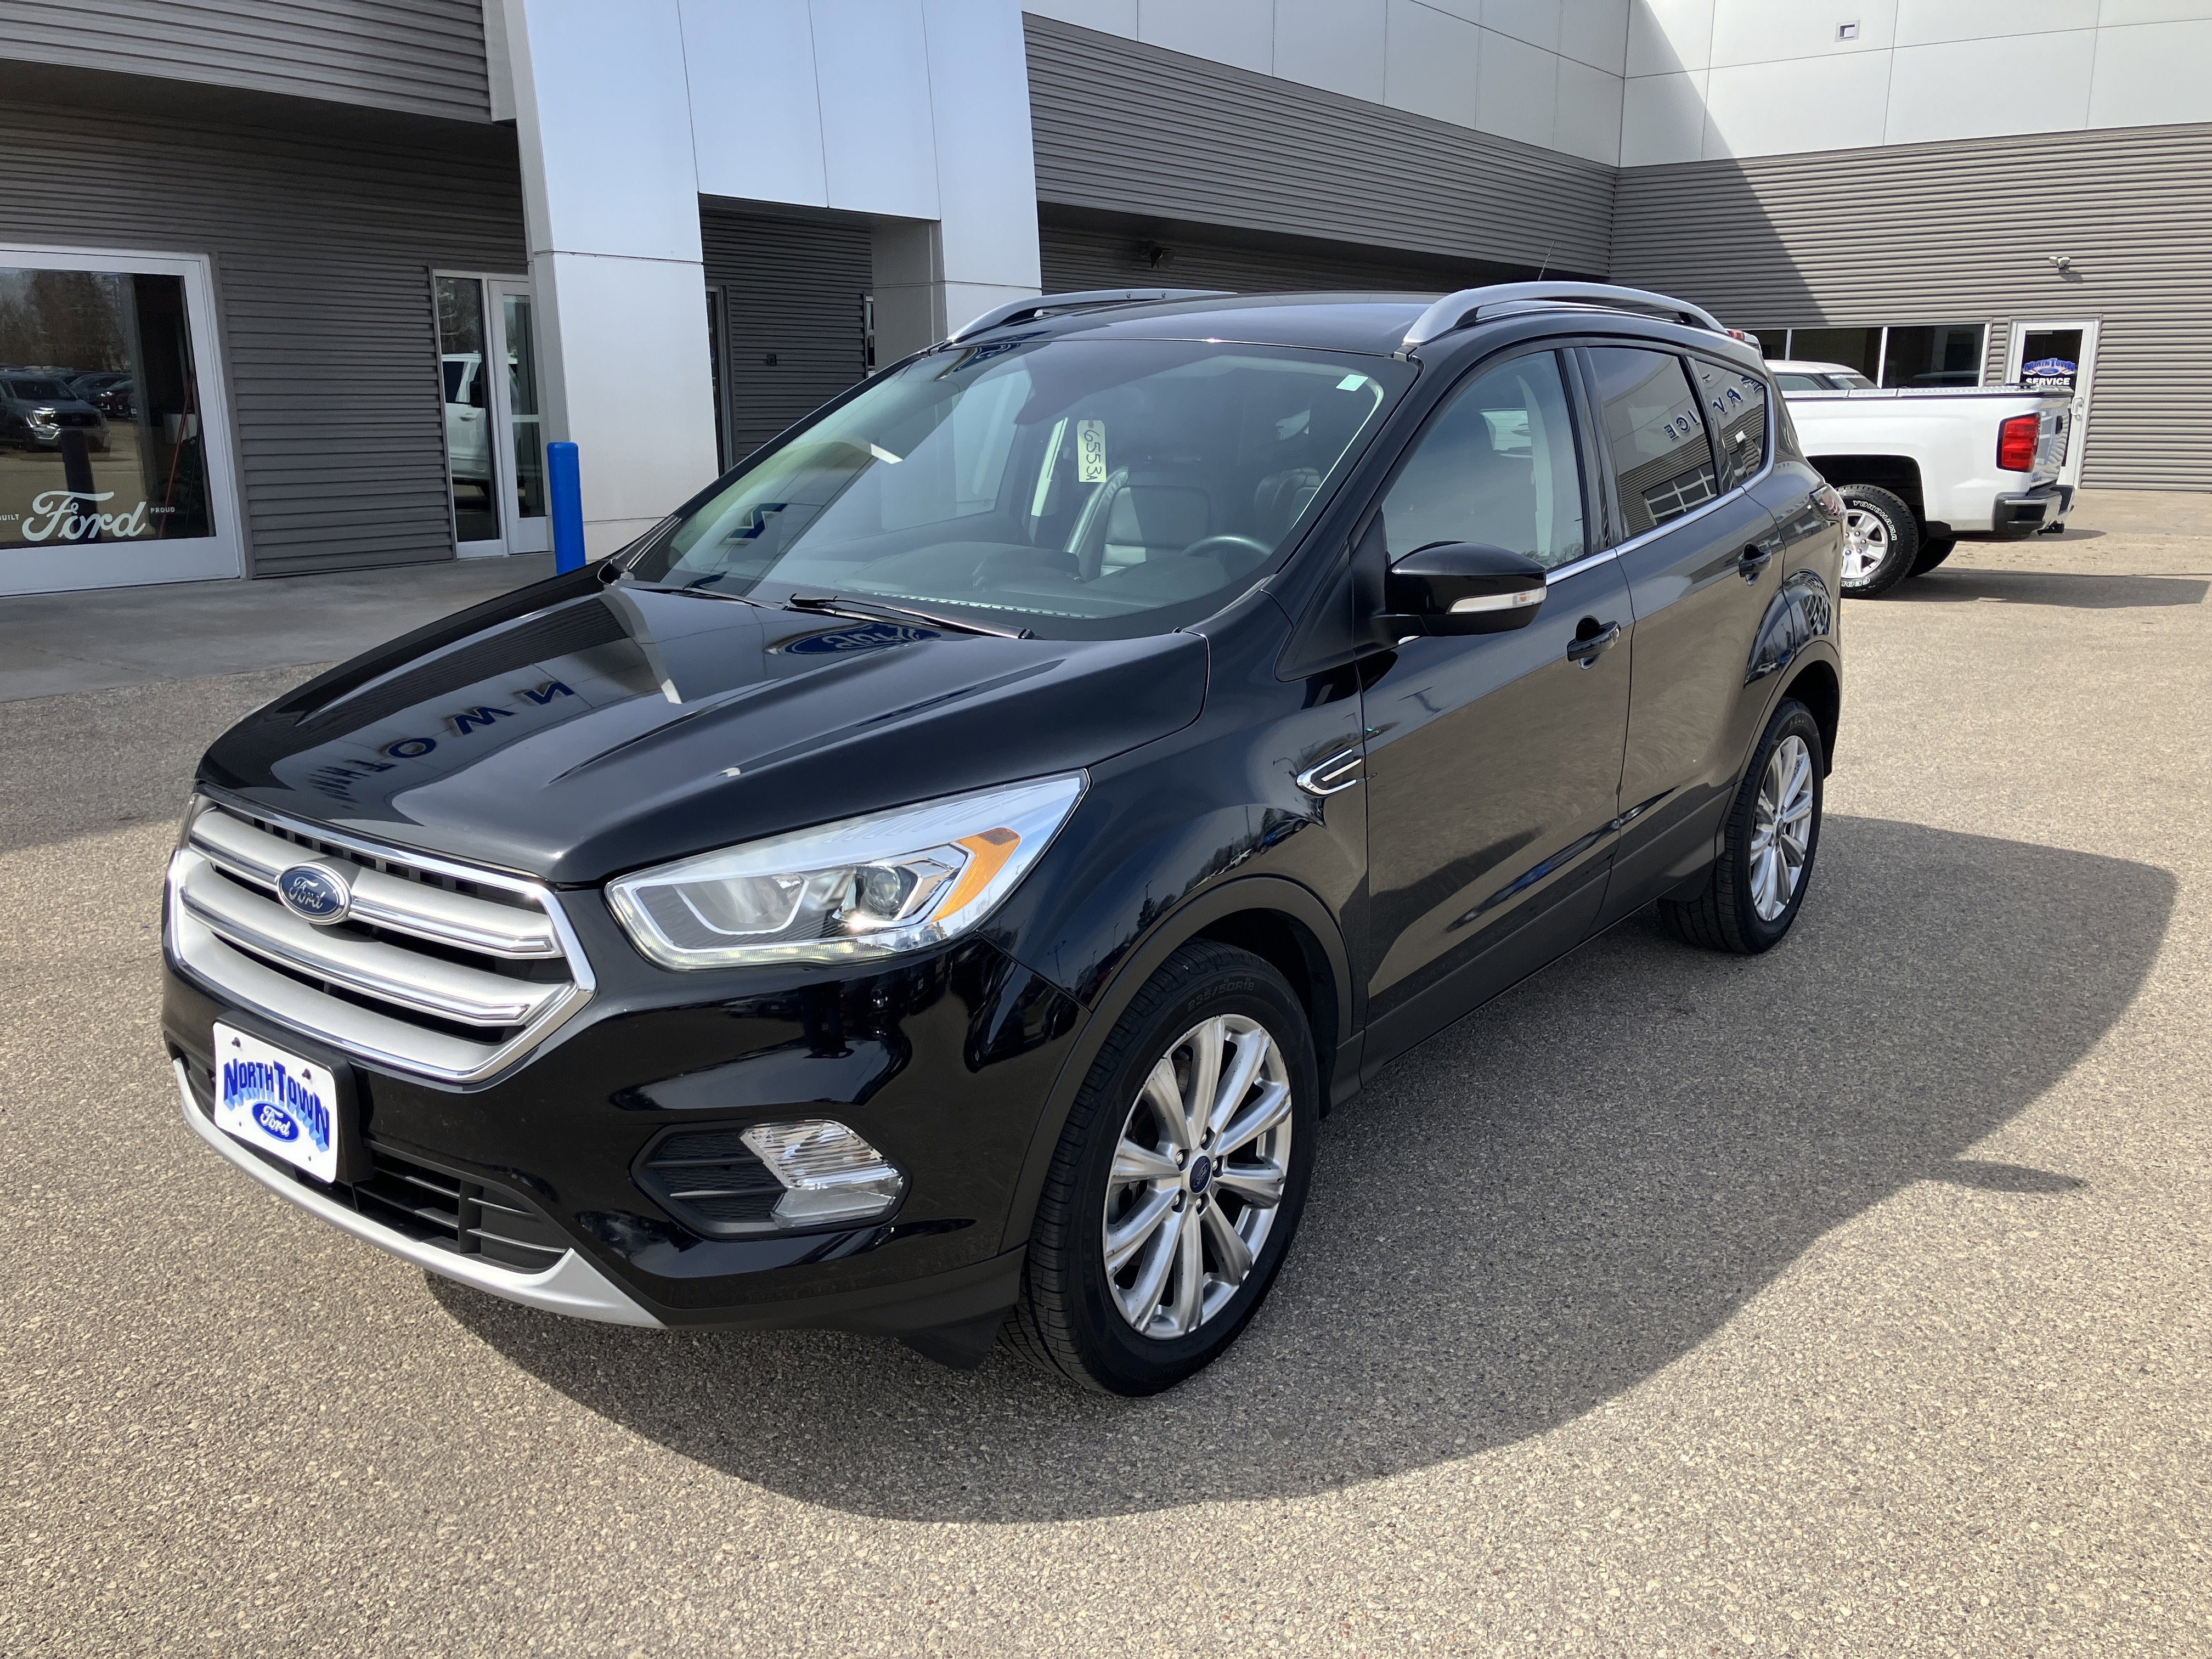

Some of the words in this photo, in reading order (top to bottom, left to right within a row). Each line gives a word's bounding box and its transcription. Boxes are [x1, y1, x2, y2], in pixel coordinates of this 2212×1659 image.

[22, 490, 146, 541] Ford
[1853, 500, 1898, 541] YOKOHAMA
[289, 876, 326, 910] Ford
[260, 1105, 291, 1137] Ford
